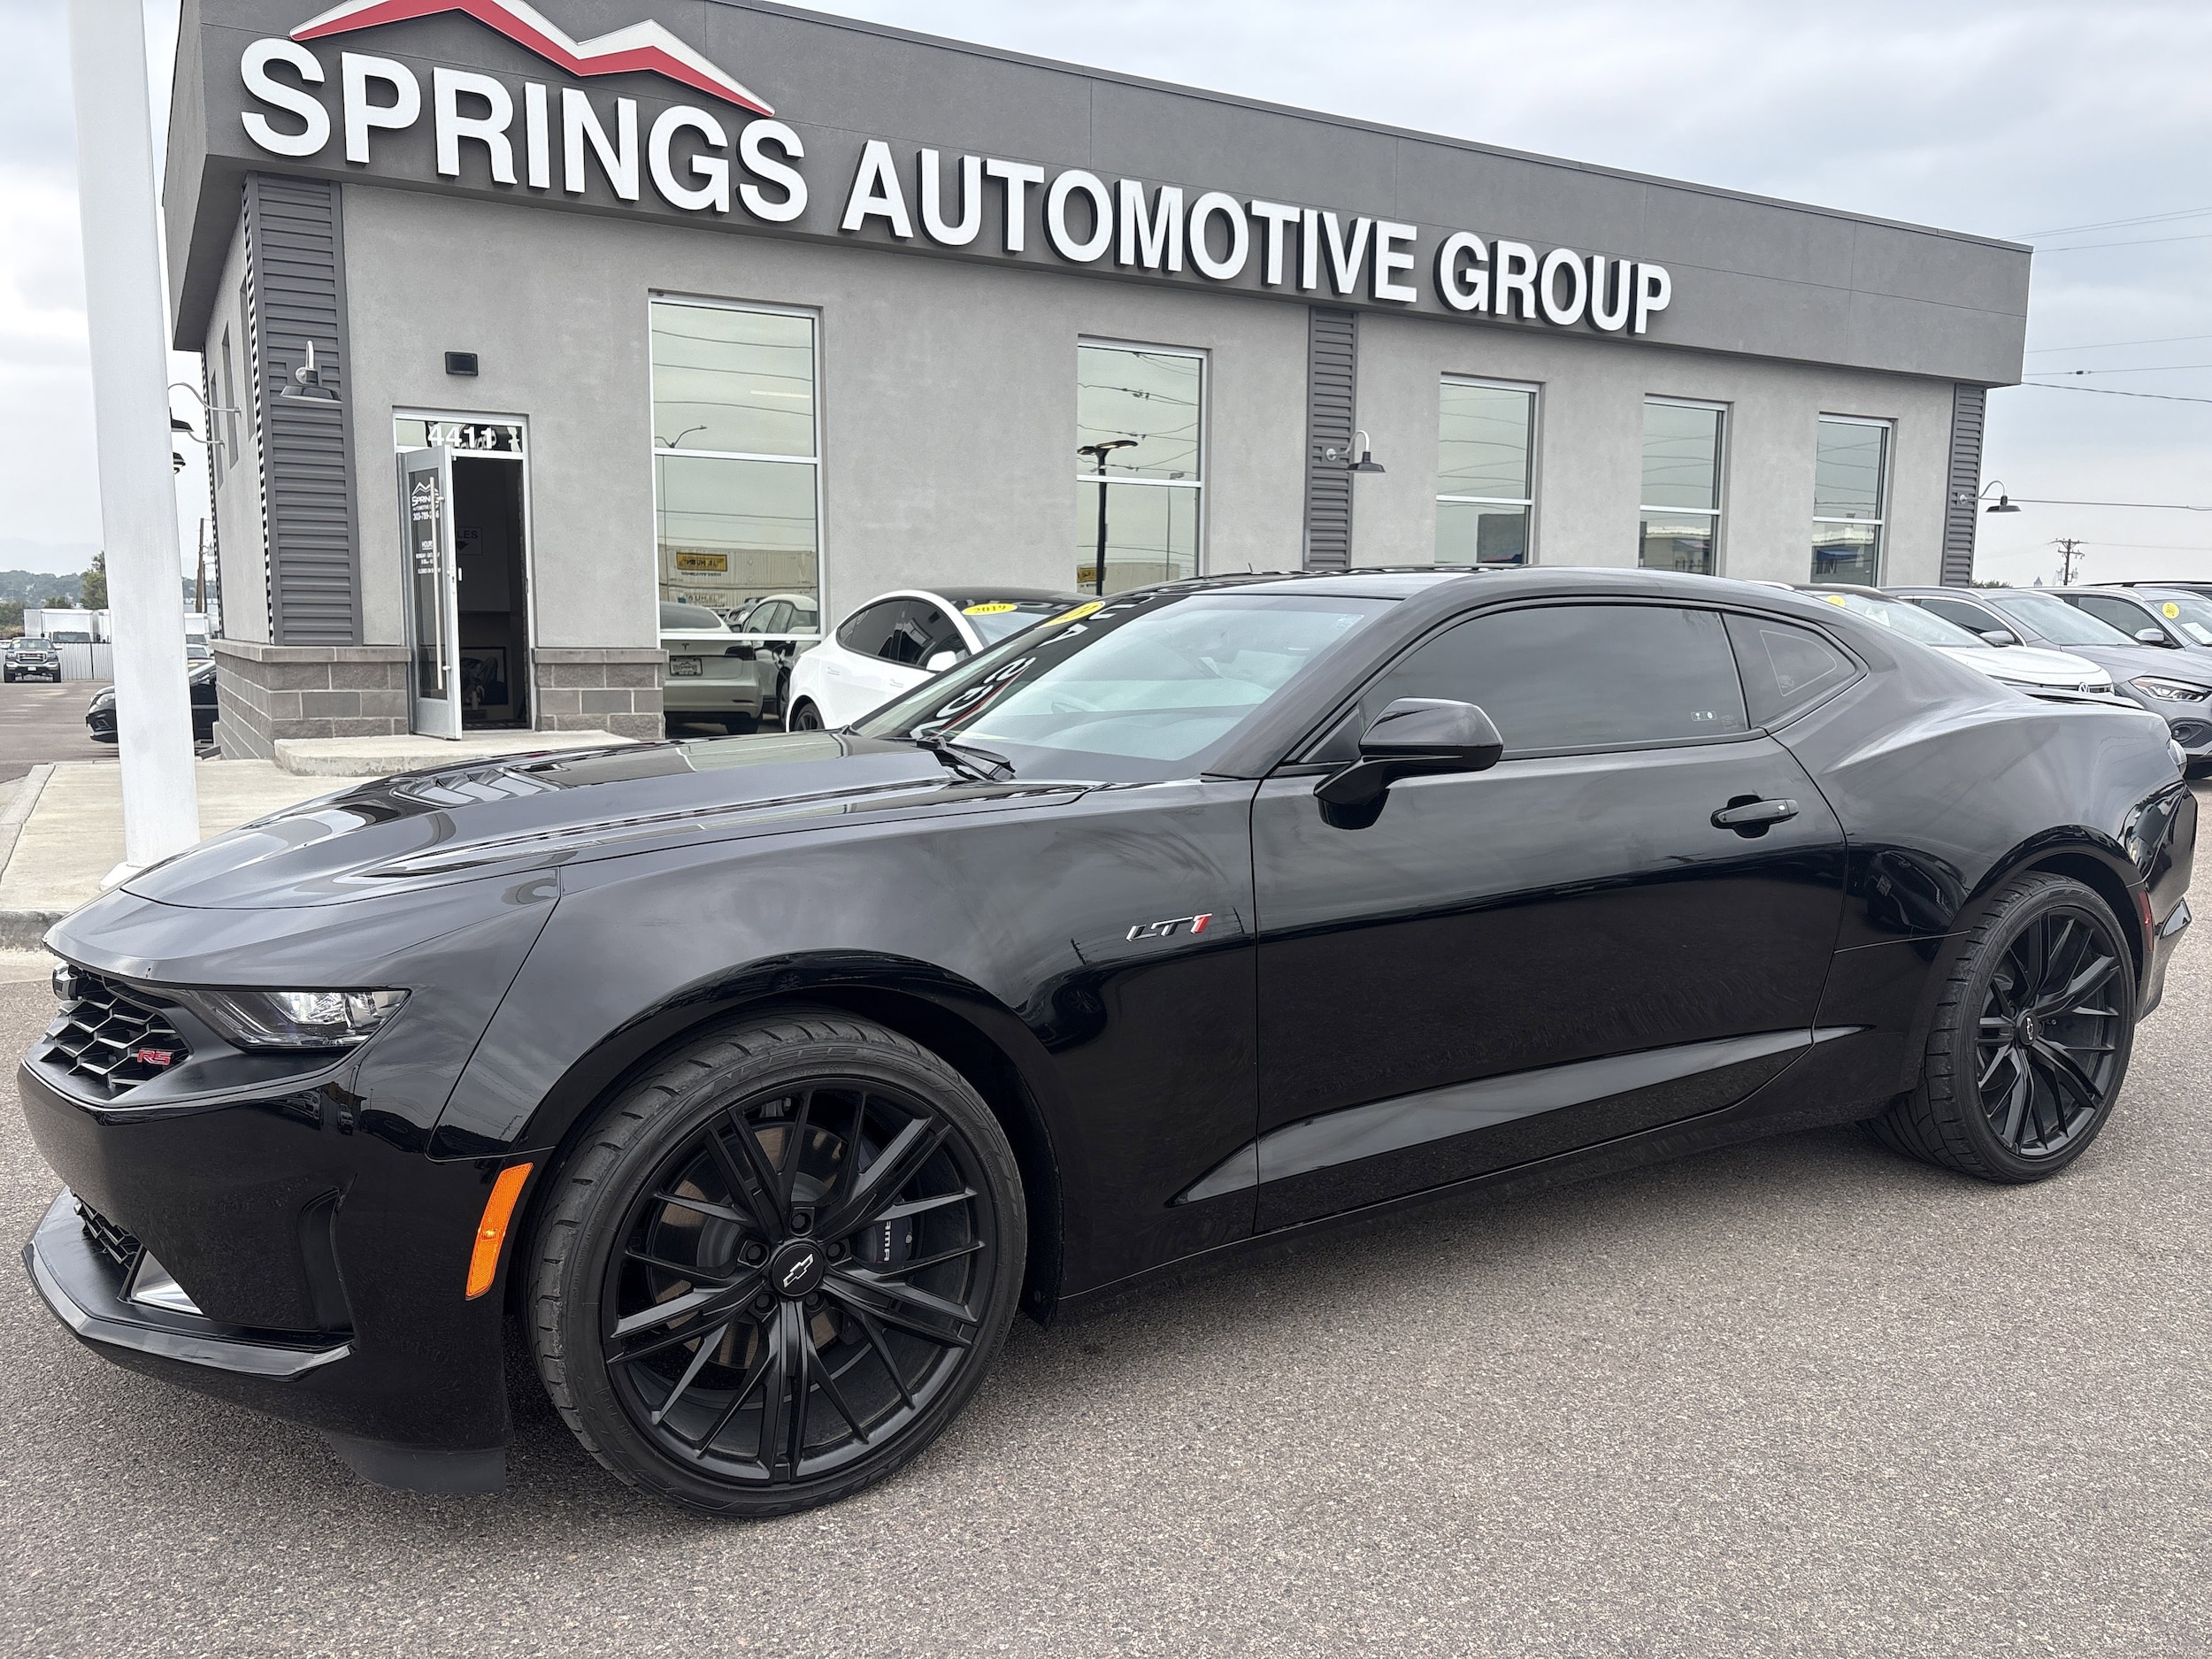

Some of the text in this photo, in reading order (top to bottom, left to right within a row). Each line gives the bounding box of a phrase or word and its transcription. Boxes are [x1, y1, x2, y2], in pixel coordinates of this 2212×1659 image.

[240, 37, 1672, 335] SPRINGS AUTOMOTIVE GROUP
[427, 424, 493, 449] 4411
[457, 530, 478, 539] LES
[973, 604, 1006, 614] 2019
[1125, 912, 1213, 942] LT1
[136, 1048, 173, 1066] RS
